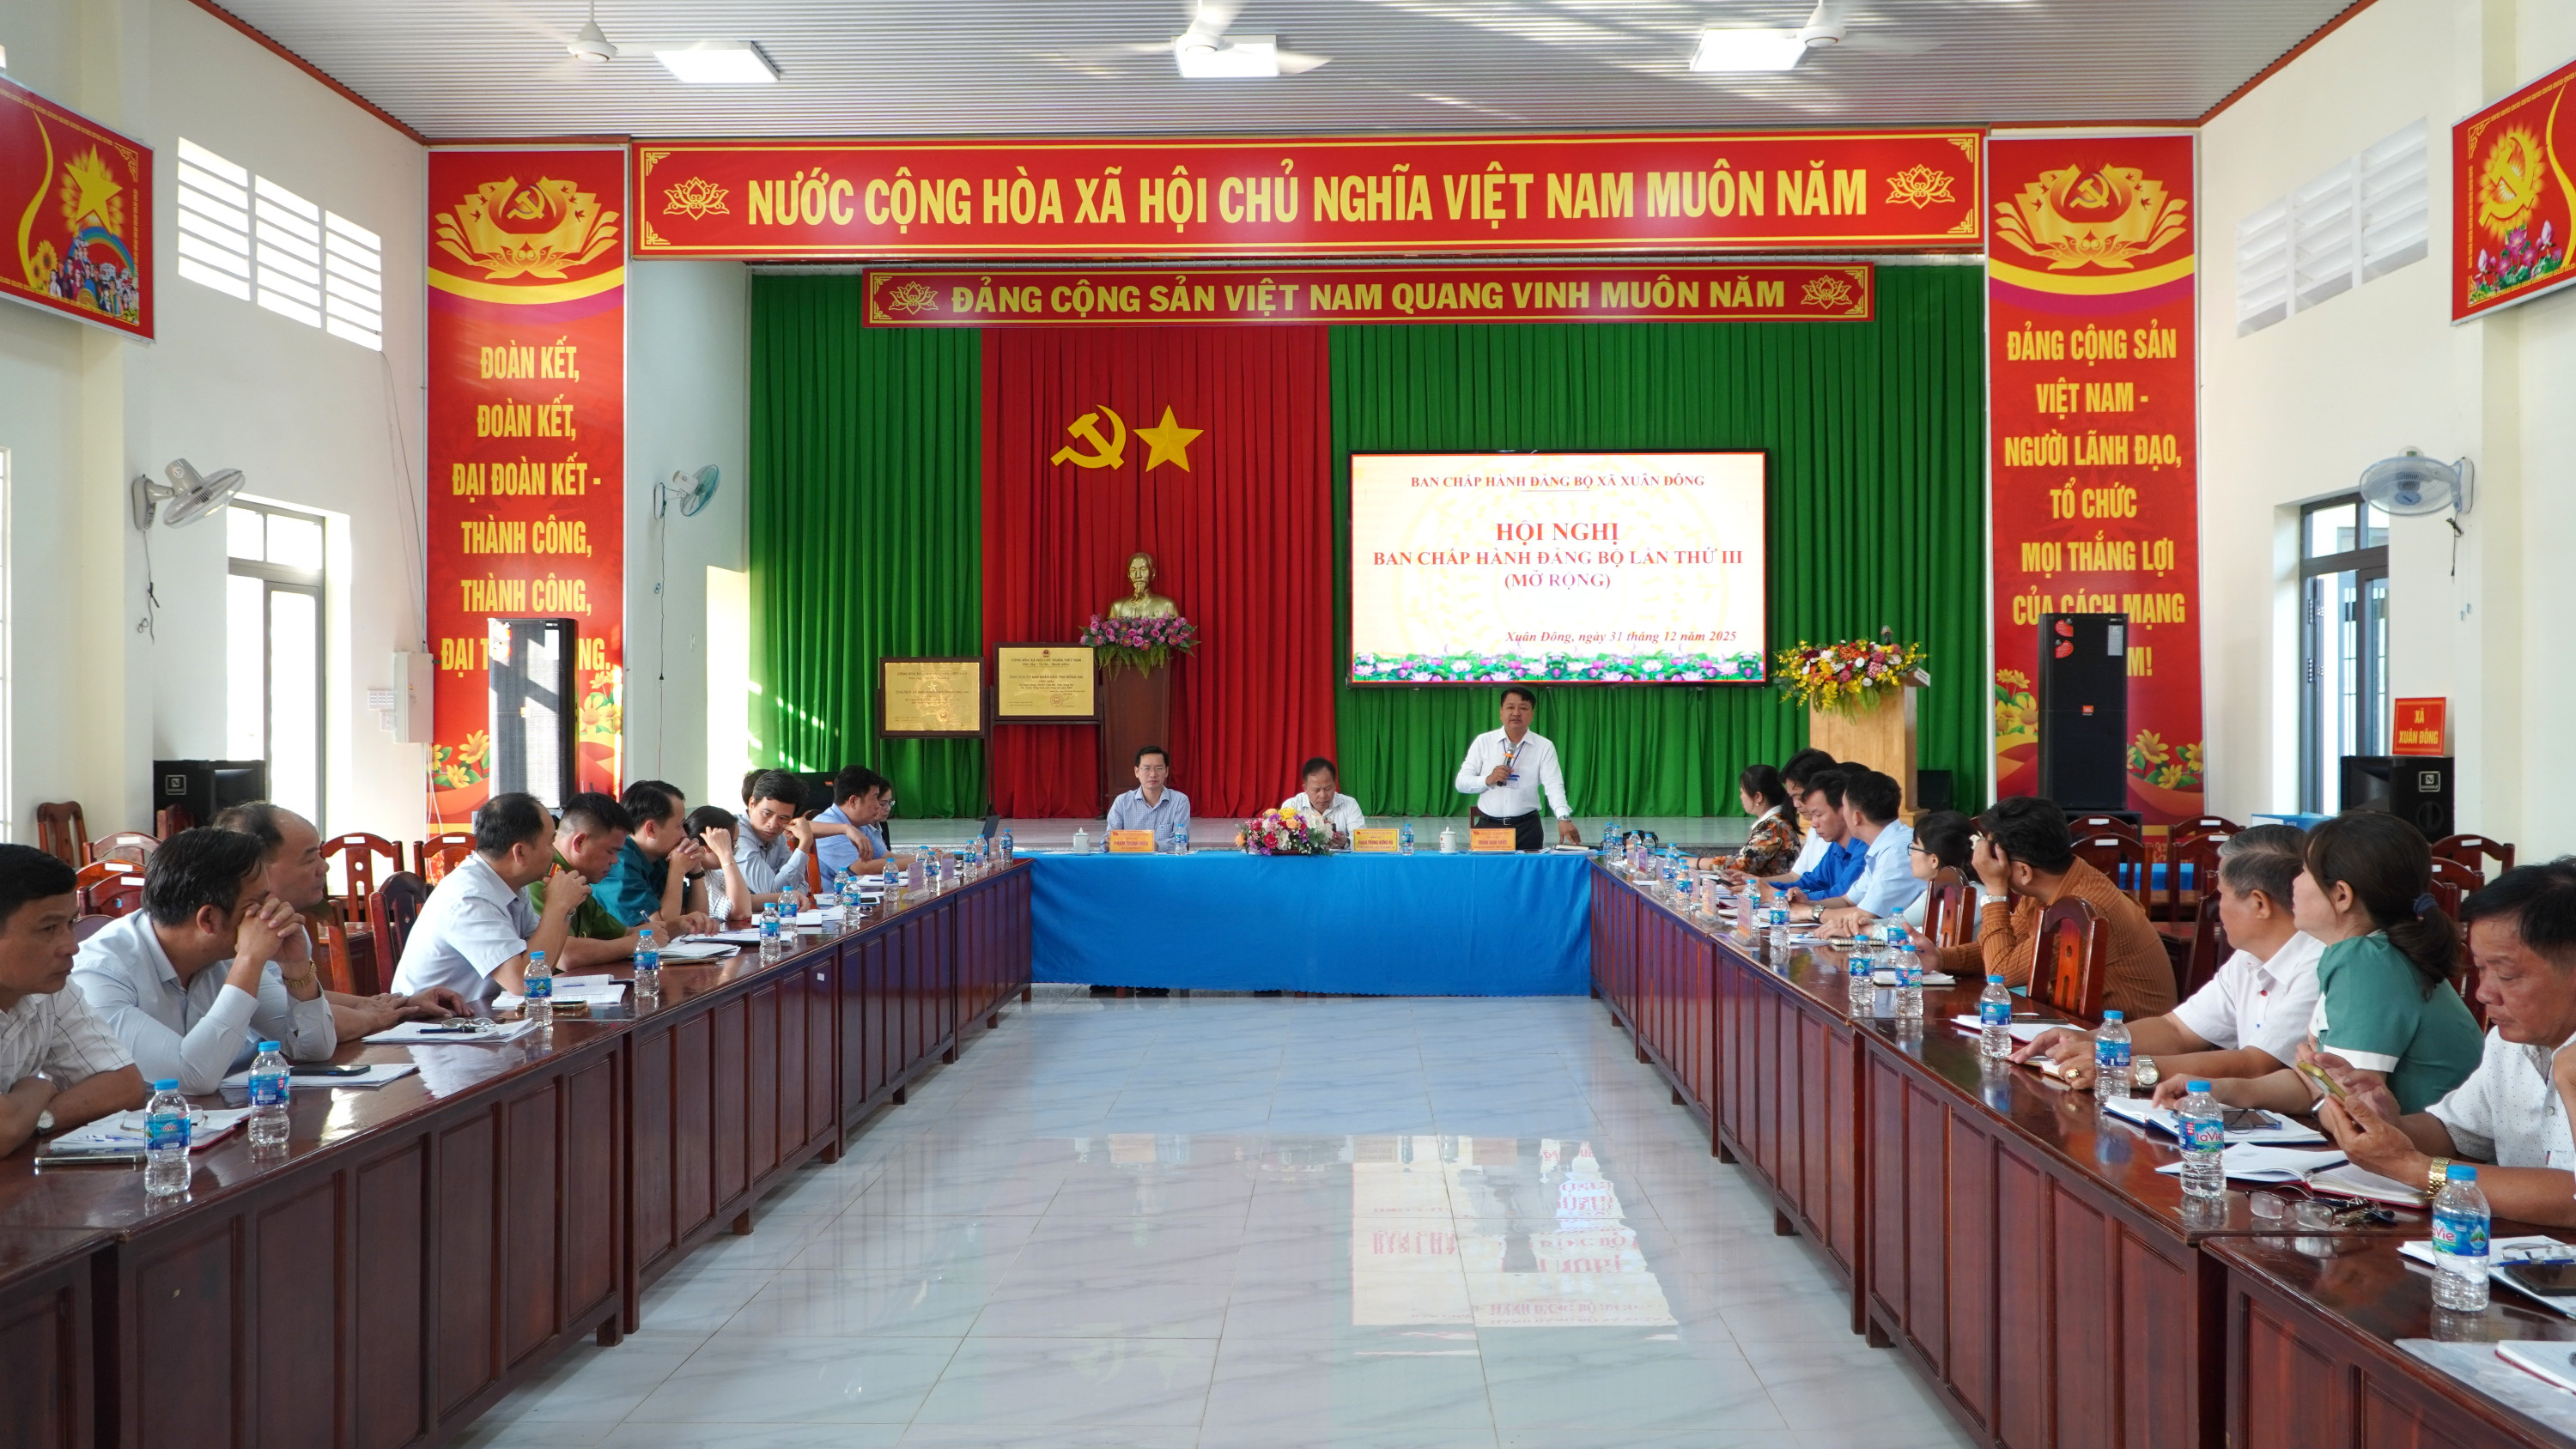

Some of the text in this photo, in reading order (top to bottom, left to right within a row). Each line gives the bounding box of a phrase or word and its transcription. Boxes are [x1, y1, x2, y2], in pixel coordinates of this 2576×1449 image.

[749, 158, 1867, 233] NƯỚC CỘNG HÒA XÃ HỘI CHỦ NGHĨA VIỆT NAM MUÔN NĂM
[951, 274, 1784, 318] ĐẢNG CỘNG SẢN VIỆT NAM QUANG VINH MUÔN NĂM
[480, 336, 580, 383] ĐOÀN KẾT,
[2007, 318, 2177, 367] ĐẢNG CỘNG SẢN
[477, 393, 576, 441] ĐOÀN KẾT,
[2036, 376, 2080, 420] VIỆT
[2086, 382, 2135, 413] NAM
[2004, 428, 2182, 471] NGƯỜI LÃNH ĐẠO,
[453, 463, 486, 503] ĐẠI
[490, 456, 546, 496] ĐOÀN
[551, 452, 588, 495] KẾT
[1411, 476, 1440, 488] BAN
[1485, 474, 1526, 487] HÀNH
[1574, 475, 1594, 489] BỘ
[1597, 474, 1617, 487] XÃ
[1620, 473, 1661, 487] XUÂN
[1663, 473, 1704, 486] ĐÔNG
[2050, 476, 2137, 519] TỔ CHỨC
[461, 514, 592, 558] THÀNH CÔNG,
[1496, 519, 1619, 546] HỘI NGHỊ
[1373, 551, 1413, 566] BAN
[1417, 548, 1471, 566] CHẤP
[1476, 548, 1531, 565] HÀNH
[1537, 547, 1592, 565] ĐẢNG
[1598, 549, 1625, 568] BỘ
[1674, 547, 1717, 565] THỨ
[1722, 550, 1743, 564] III
[2021, 530, 2174, 579] MỌI THẮNG LỢI
[460, 572, 592, 615] THÀNH CÔNG,
[1504, 569, 1611, 591] (MỞ RỘNG)
[2013, 585, 2054, 625] CỦA
[2123, 592, 2185, 630] MẠNG
[440, 638, 474, 678] ĐẠI
[1505, 631, 1737, 645] Xuân Đông, ngày 31 tháng 12 năm 2025
[2196, 1131, 2223, 1142] laVie
